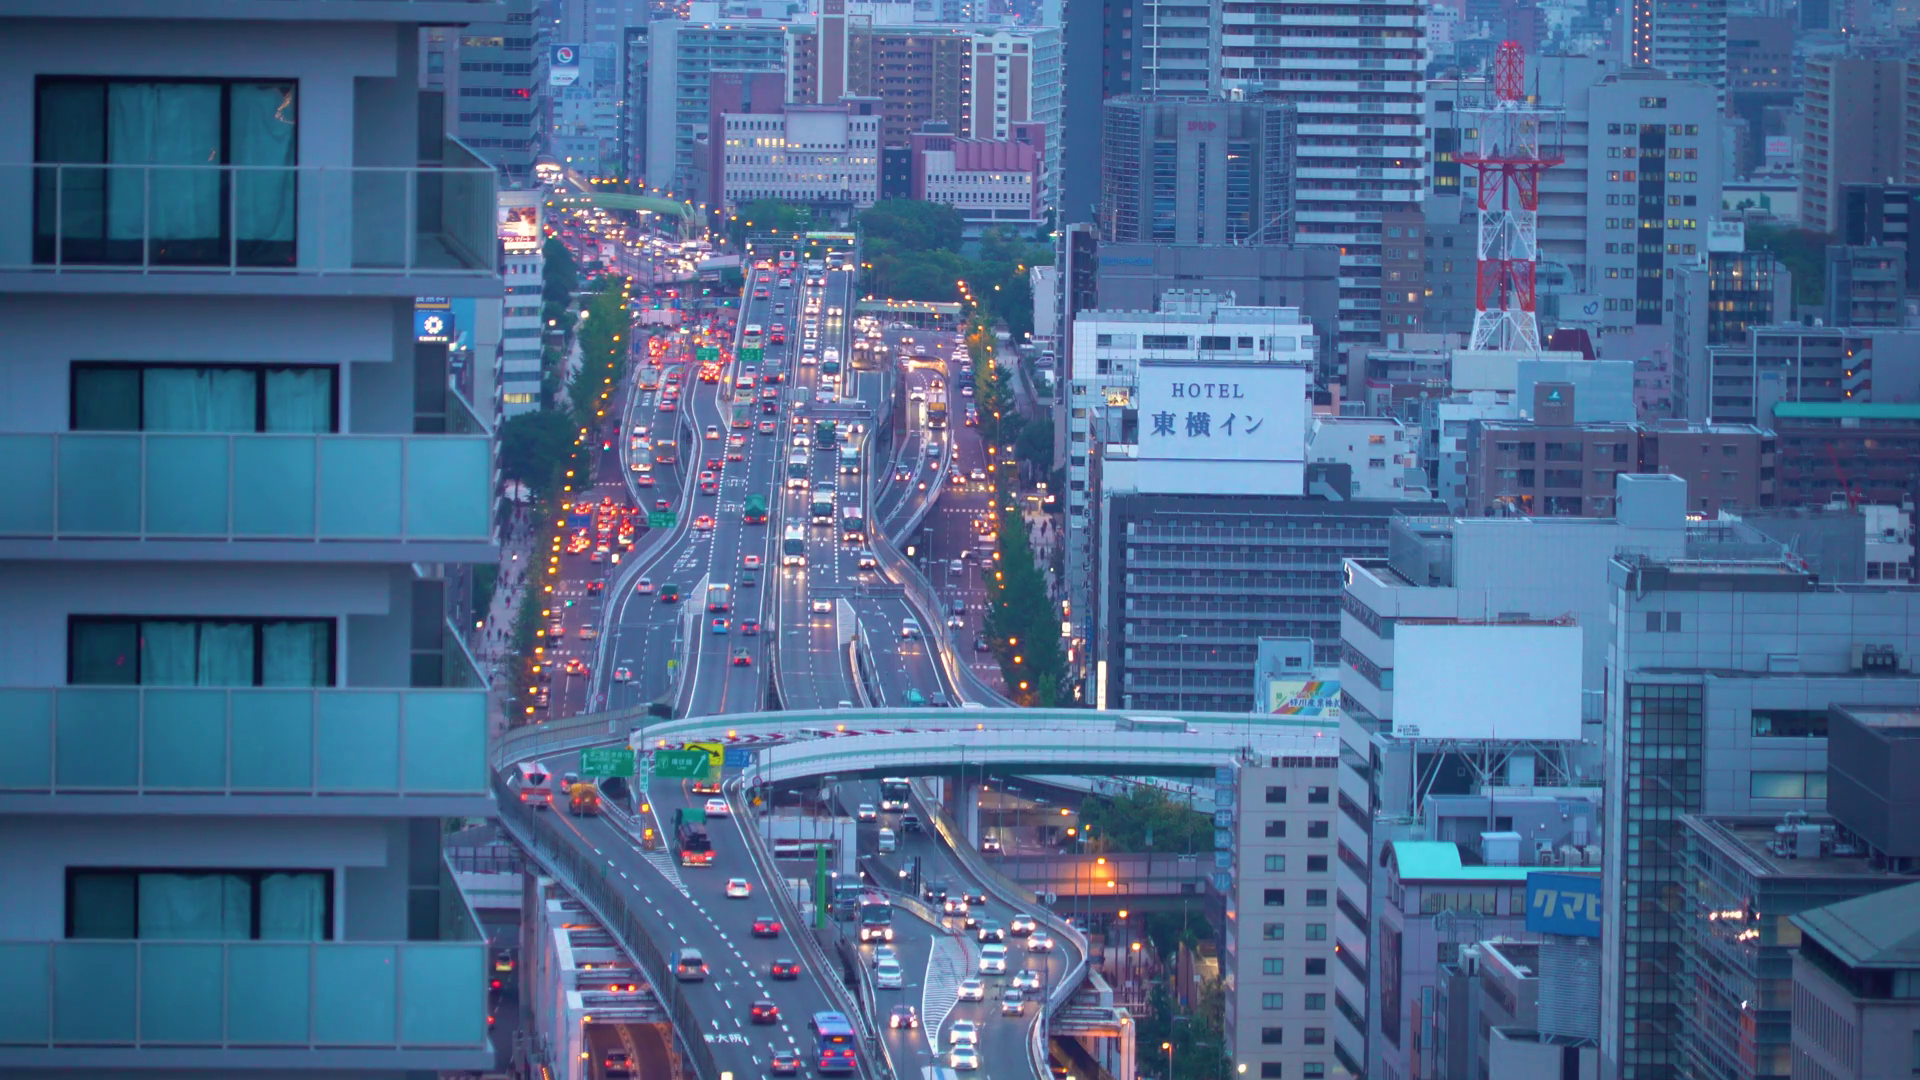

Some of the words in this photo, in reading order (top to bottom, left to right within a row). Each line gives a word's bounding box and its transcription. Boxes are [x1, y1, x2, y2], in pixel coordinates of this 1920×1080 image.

[1172, 383, 1244, 398] HOTEL
[1151, 411, 1264, 437] 東横イン
